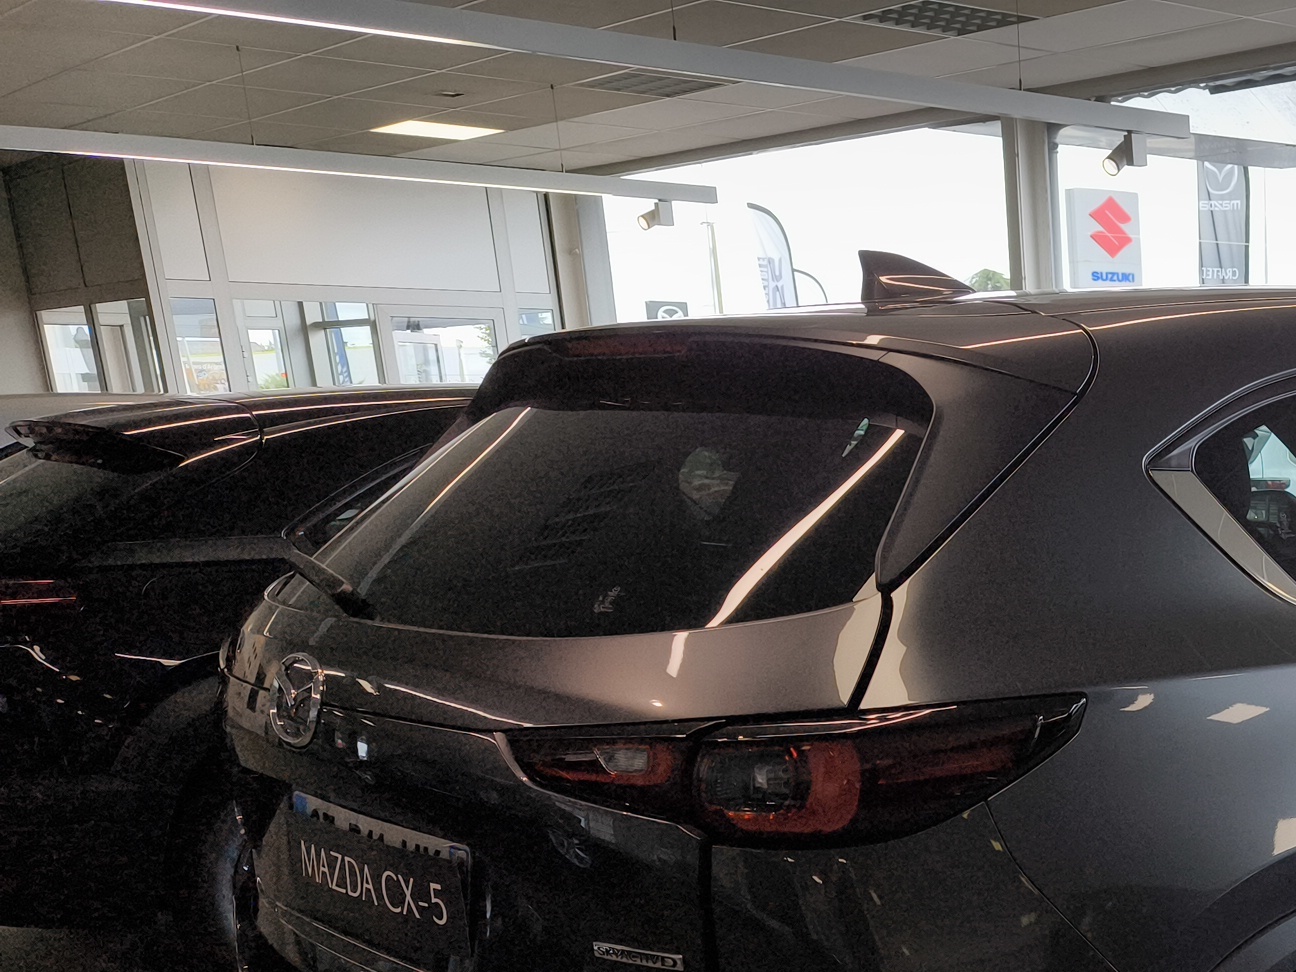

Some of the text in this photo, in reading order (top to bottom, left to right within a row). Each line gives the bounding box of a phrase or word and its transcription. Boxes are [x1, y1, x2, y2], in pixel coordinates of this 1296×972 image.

[1091, 271, 1135, 283] SUZUKI
[300, 839, 448, 926] MAZDA CX-5
